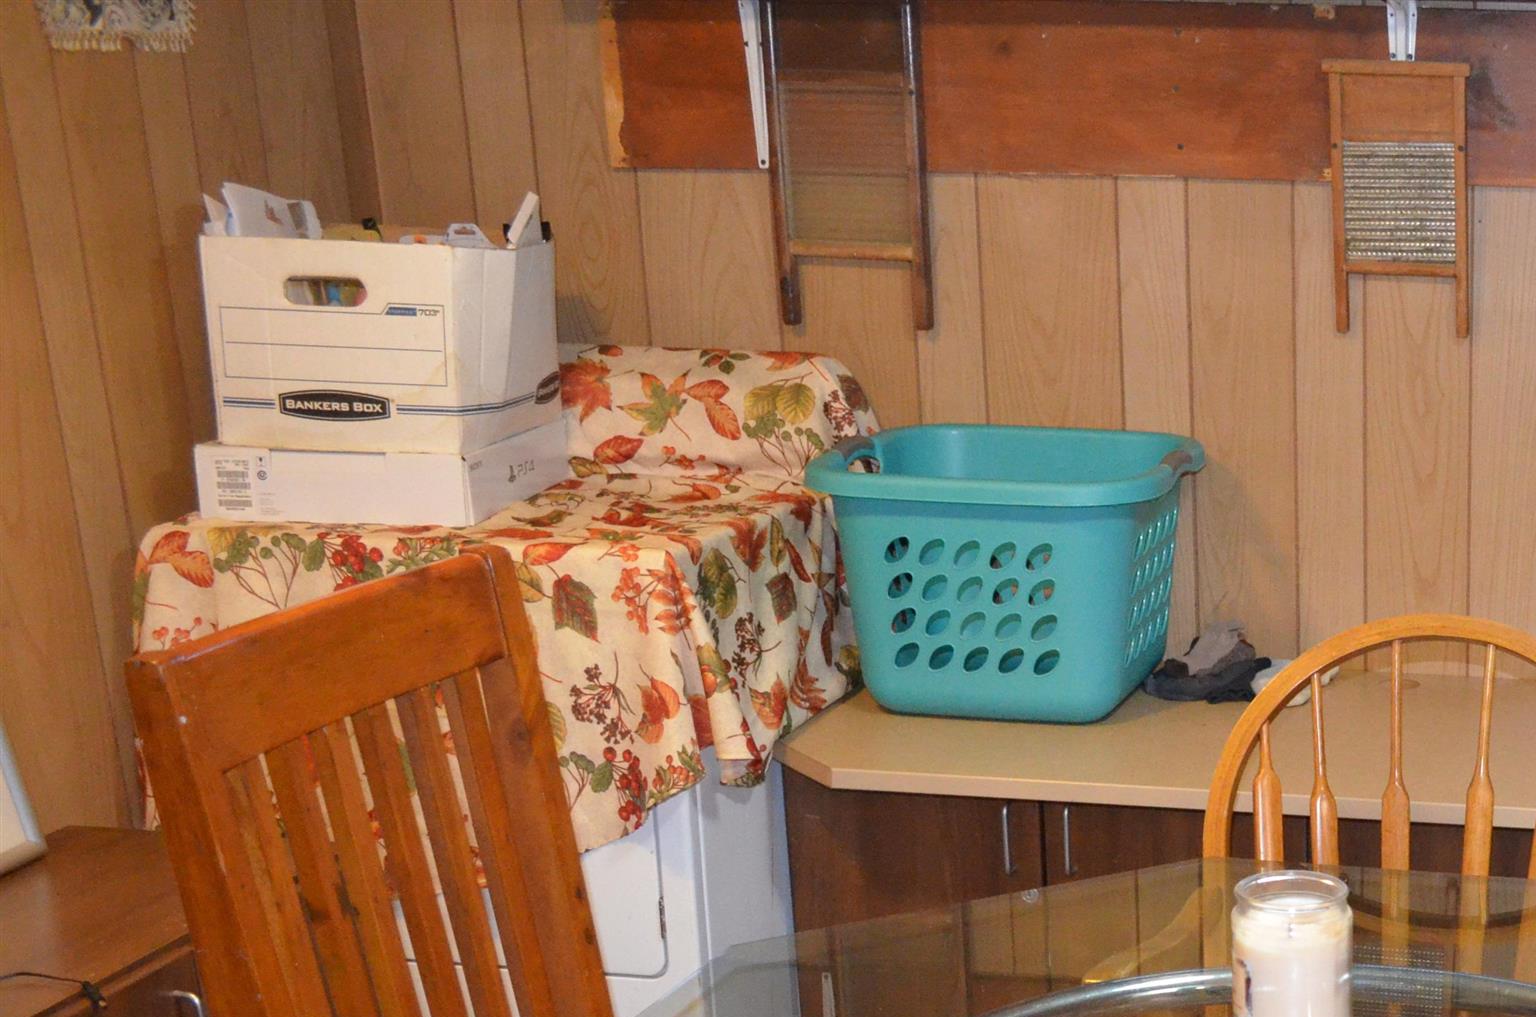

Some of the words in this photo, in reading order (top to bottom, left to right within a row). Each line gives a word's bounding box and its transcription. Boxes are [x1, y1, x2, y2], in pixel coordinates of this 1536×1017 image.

[285, 399, 350, 412] BANKERS
[353, 401, 384, 413] BOX
[517, 459, 536, 477] PS4
